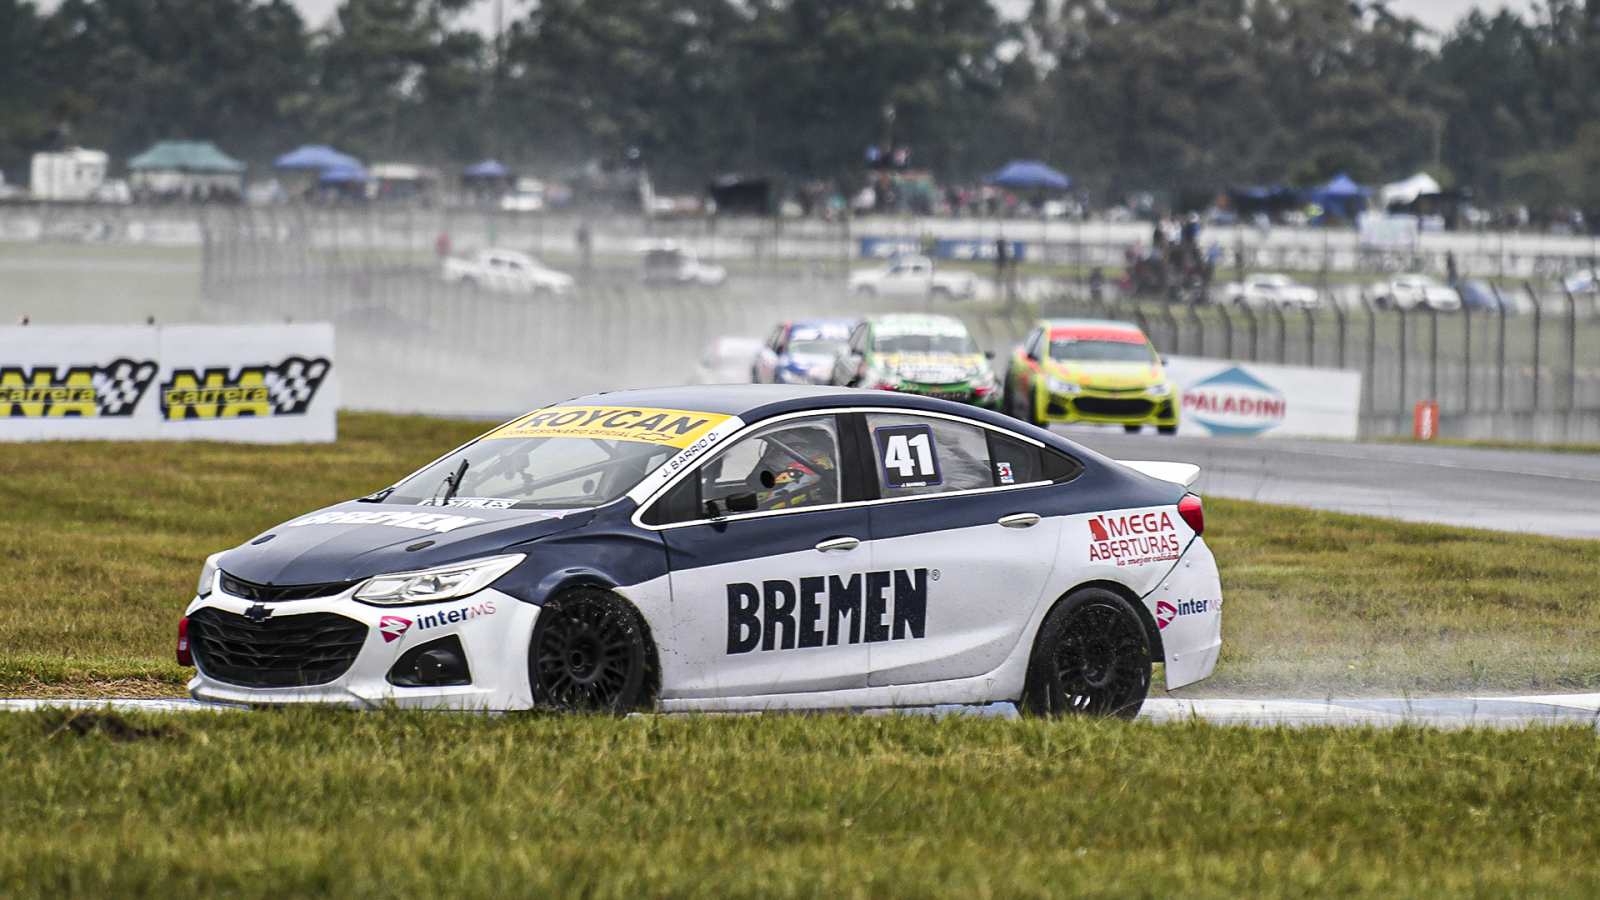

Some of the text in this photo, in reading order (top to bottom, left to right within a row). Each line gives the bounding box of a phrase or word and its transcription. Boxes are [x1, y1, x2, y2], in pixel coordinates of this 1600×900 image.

[165, 387, 270, 406] carrera
[1182, 392, 1286, 418] PALADINI
[515, 410, 709, 435] ROYCAN
[589, 430, 630, 438] OFICIAL
[670, 438, 708, 470] BARRIO
[884, 433, 935, 477] 41
[288, 511, 487, 534] BREMEN
[1108, 511, 1175, 537] MEGA
[1090, 534, 1180, 562] ABERTURAS
[417, 601, 497, 631] interMS
[726, 568, 928, 656] BREMEN
